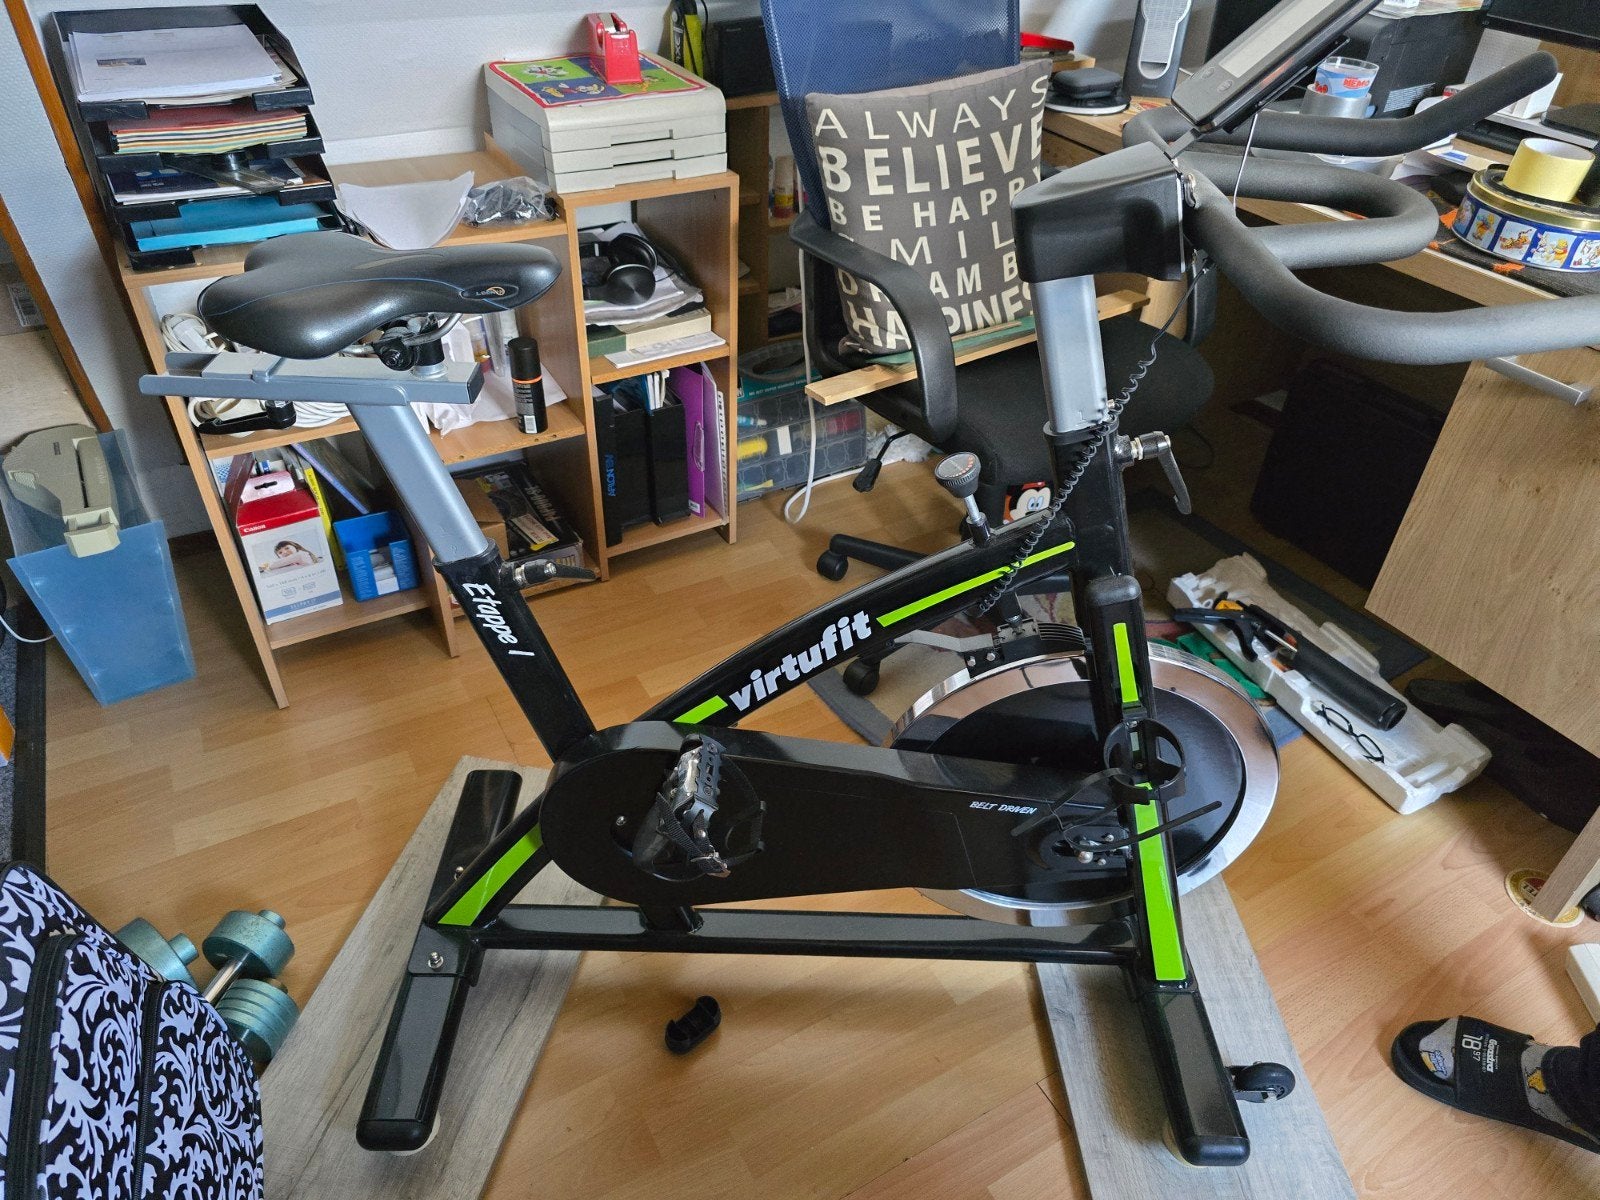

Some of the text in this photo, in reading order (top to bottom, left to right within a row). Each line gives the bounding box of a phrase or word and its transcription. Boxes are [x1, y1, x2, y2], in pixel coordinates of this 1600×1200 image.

[814, 74, 1049, 140] ALWAYS
[818, 108, 1044, 196] BELIEVE
[829, 166, 1041, 231] BE HAPP
[243, 523, 267, 534] Canon
[462, 582, 519, 644] Etappe
[728, 610, 872, 712] virtufit
[969, 801, 1038, 815] BELT DRIVEN
[1486, 1038, 1498, 1073] Gaastra
